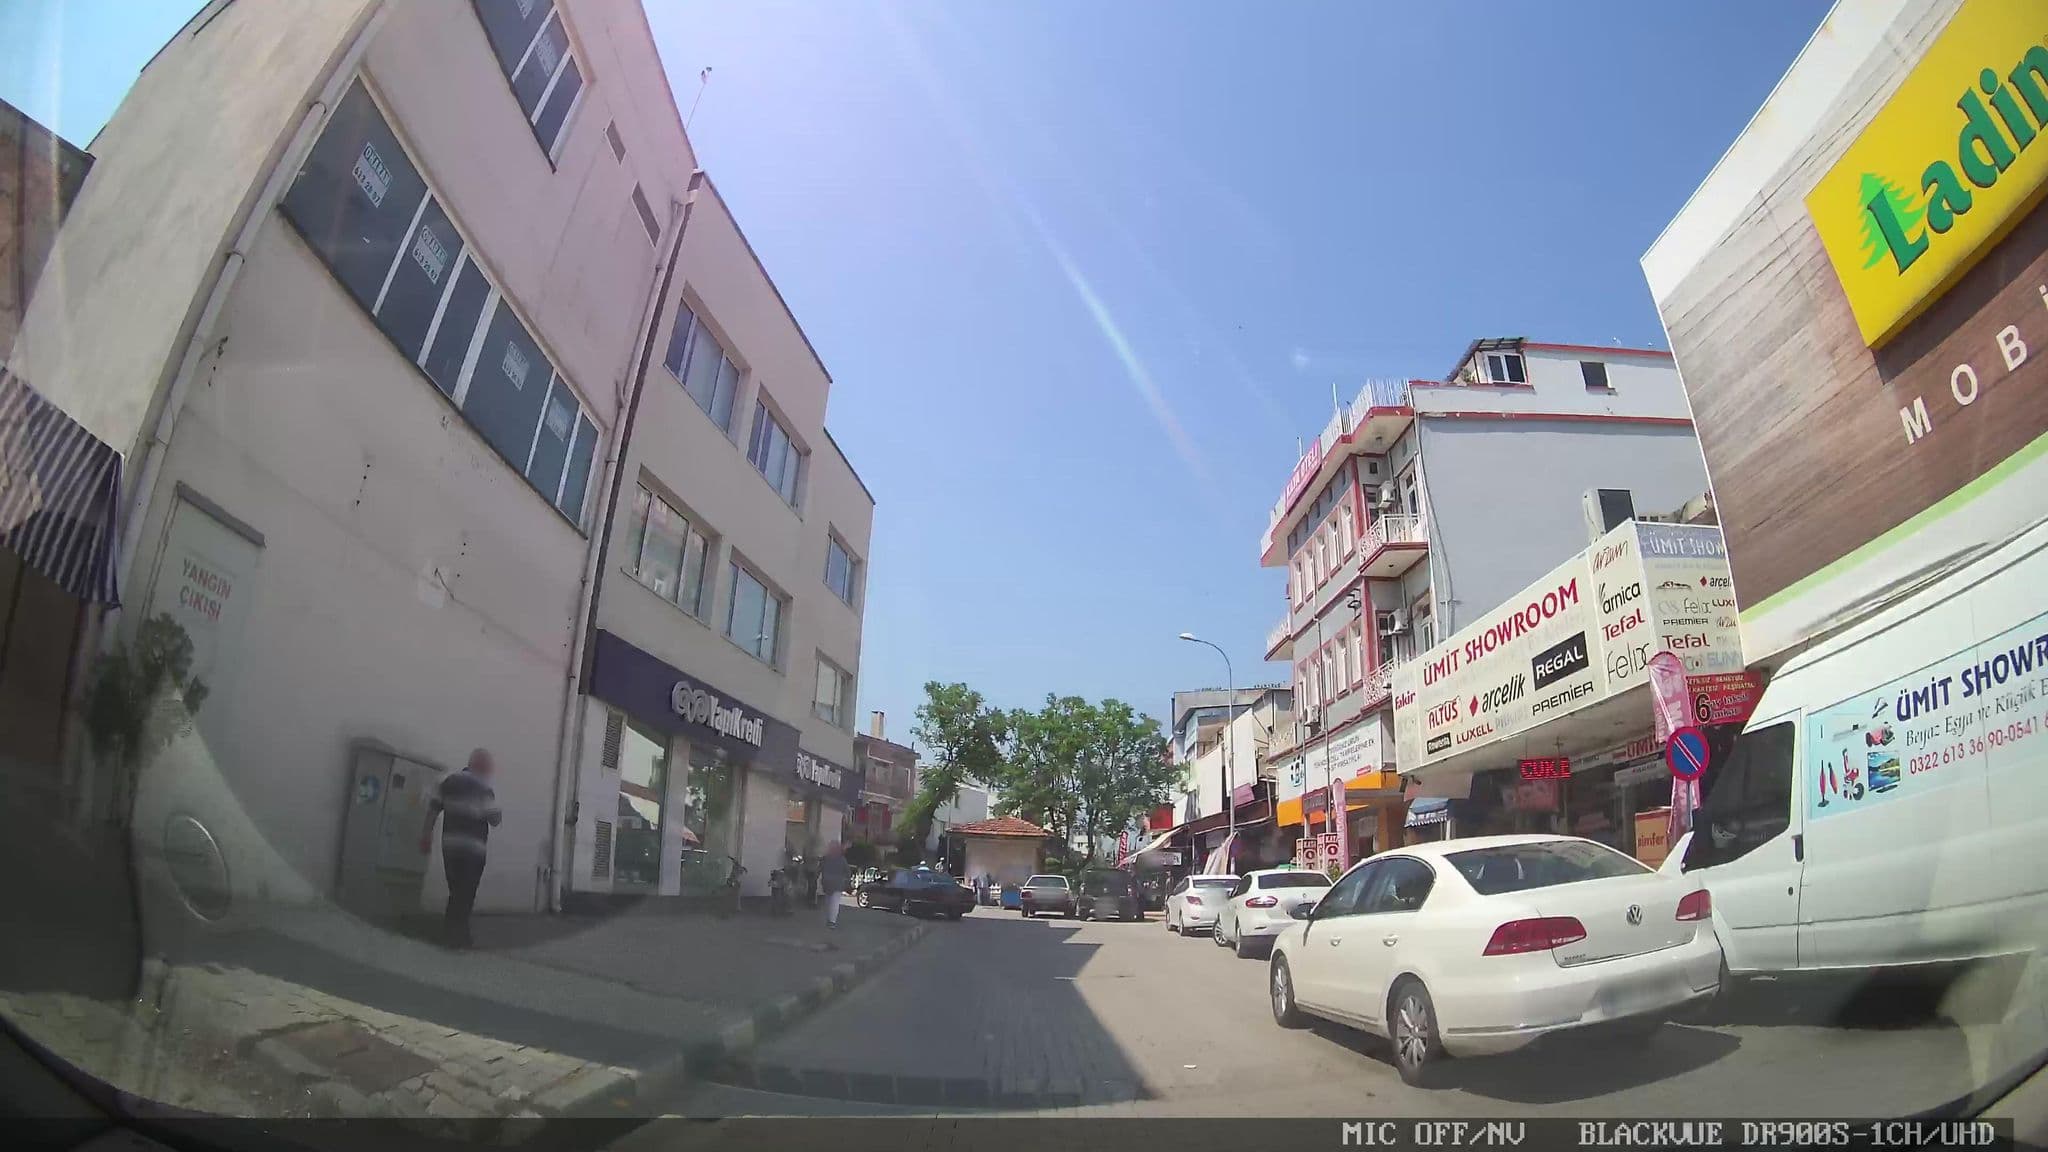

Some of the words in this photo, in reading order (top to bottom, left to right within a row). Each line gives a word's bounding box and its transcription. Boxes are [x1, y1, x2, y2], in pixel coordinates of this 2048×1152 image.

[182, 557, 232, 601] YANGIN
[1423, 649, 1460, 687] ÜMİT
[1465, 577, 1579, 665] SHOWROOM
[1602, 607, 1646, 642] Tefal
[1662, 633, 1711, 650] Tefal
[1535, 646, 1583, 680] REGAL
[1482, 672, 1526, 713] arçelik
[1695, 692, 1712, 724] 6
[1896, 677, 1952, 722] ÜMİT
[1427, 700, 1458, 729] ALTUS
[1456, 723, 1493, 744] LUXELL
[1910, 751, 1938, 775] 0322
[1943, 742, 1965, 764] 613
[1969, 736, 1984, 756] 36
